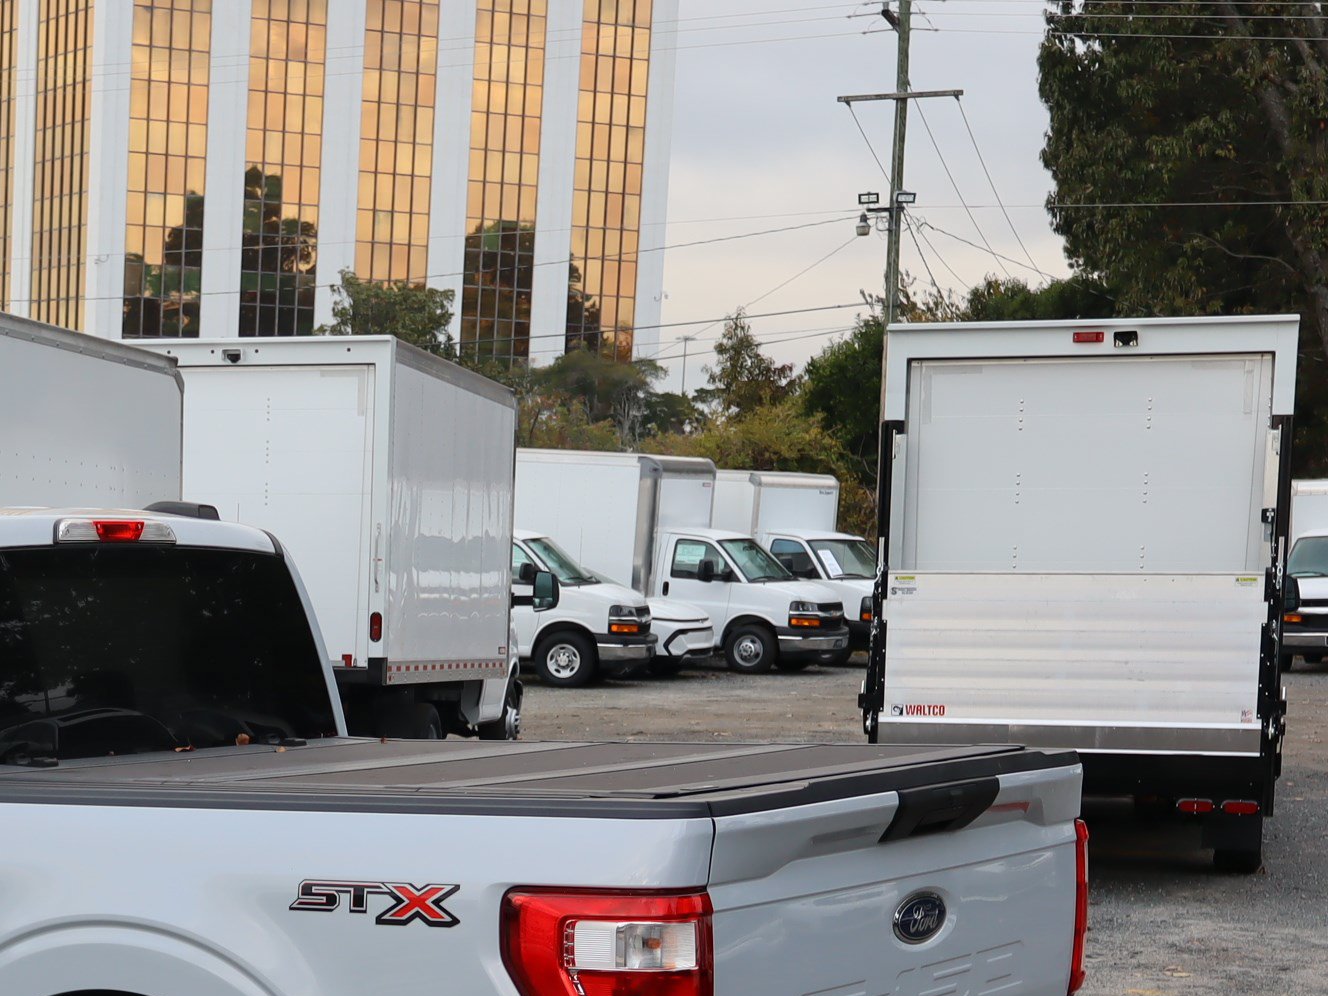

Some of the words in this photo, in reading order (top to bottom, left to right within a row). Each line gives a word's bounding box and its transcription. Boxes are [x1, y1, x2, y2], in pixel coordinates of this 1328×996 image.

[905, 704, 946, 716] WALTCO
[289, 879, 461, 928] STX
[909, 904, 939, 933] Ford
